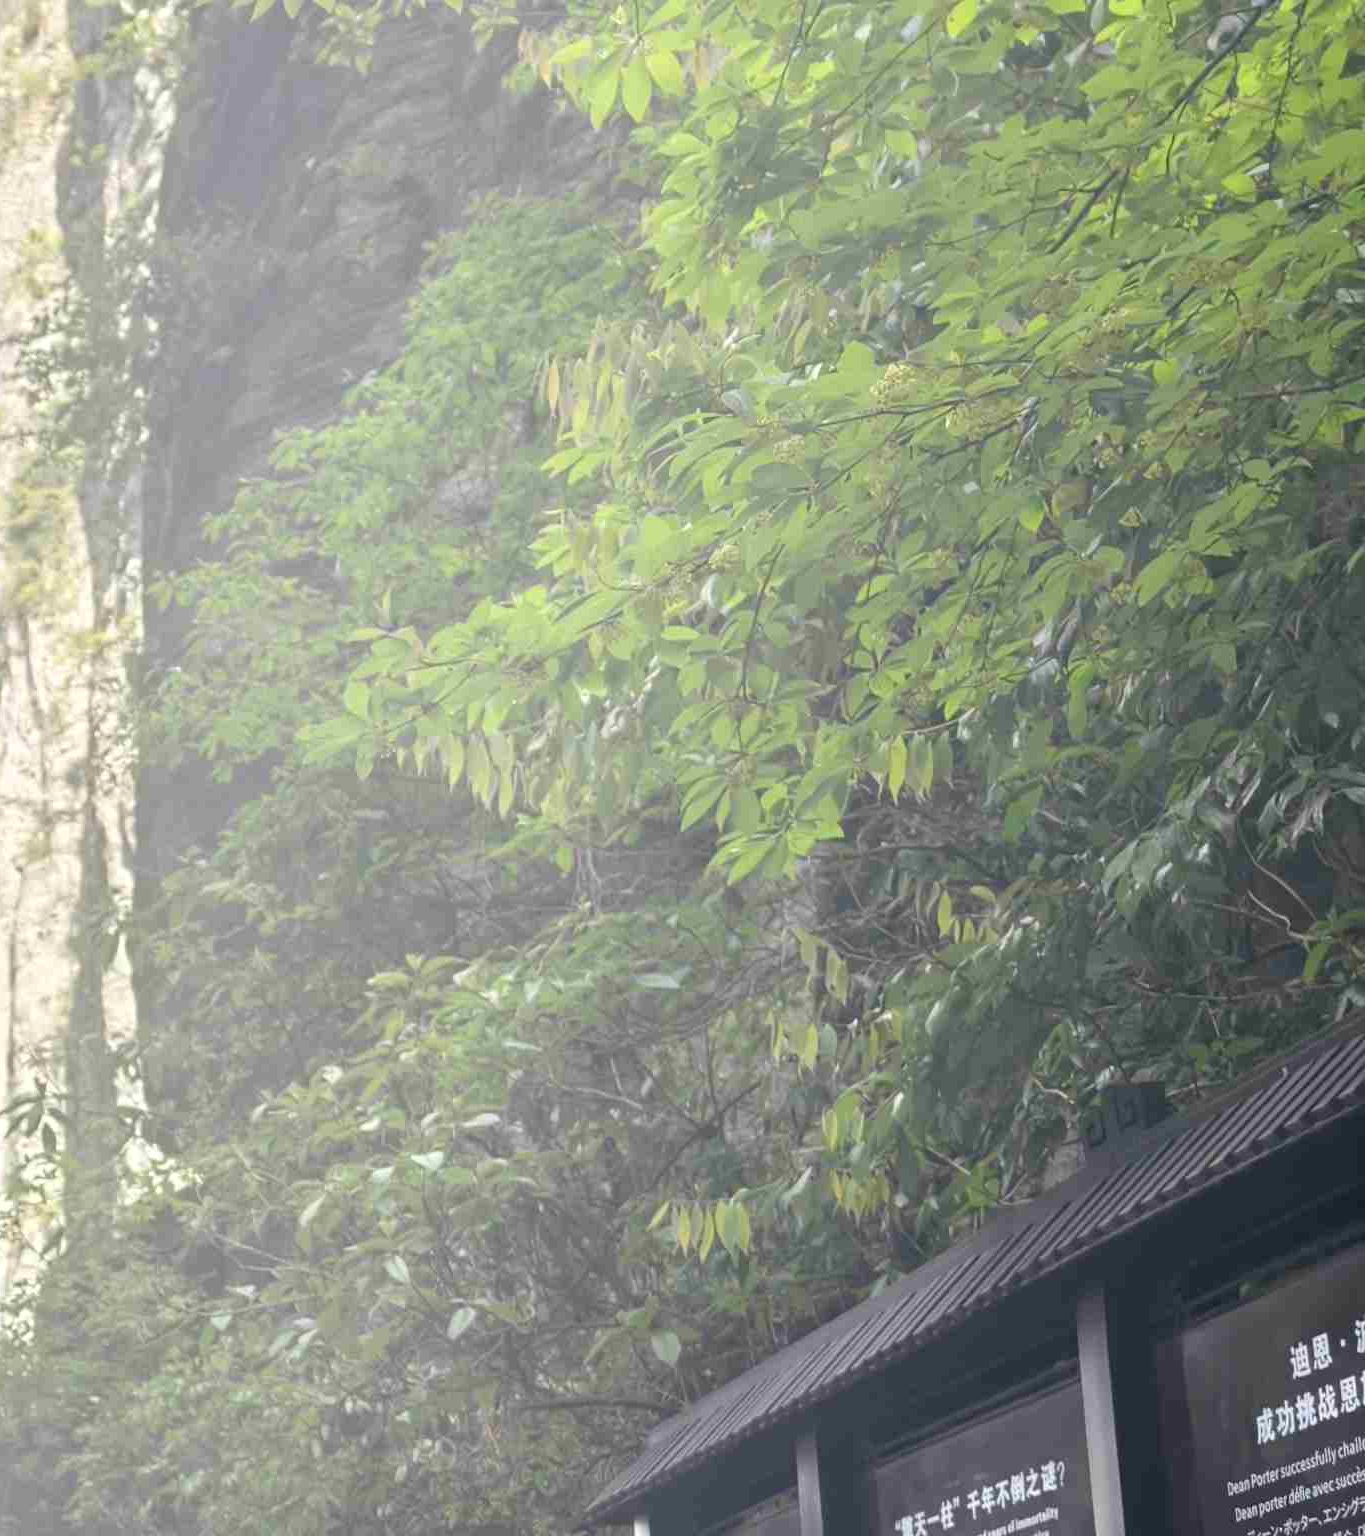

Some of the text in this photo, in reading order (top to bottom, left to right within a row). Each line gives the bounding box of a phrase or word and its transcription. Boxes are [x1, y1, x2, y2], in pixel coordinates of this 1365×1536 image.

[1256, 1367, 1365, 1445] 成功挑战恩
[1226, 1479, 1251, 1497] Dean
[1250, 1467, 1280, 1488] Porter
[1280, 1446, 1336, 1479] successfully
[1234, 1505, 1258, 1523] Dean
[1258, 1494, 1287, 1518] porter
[1312, 1479, 1335, 1498] avec
